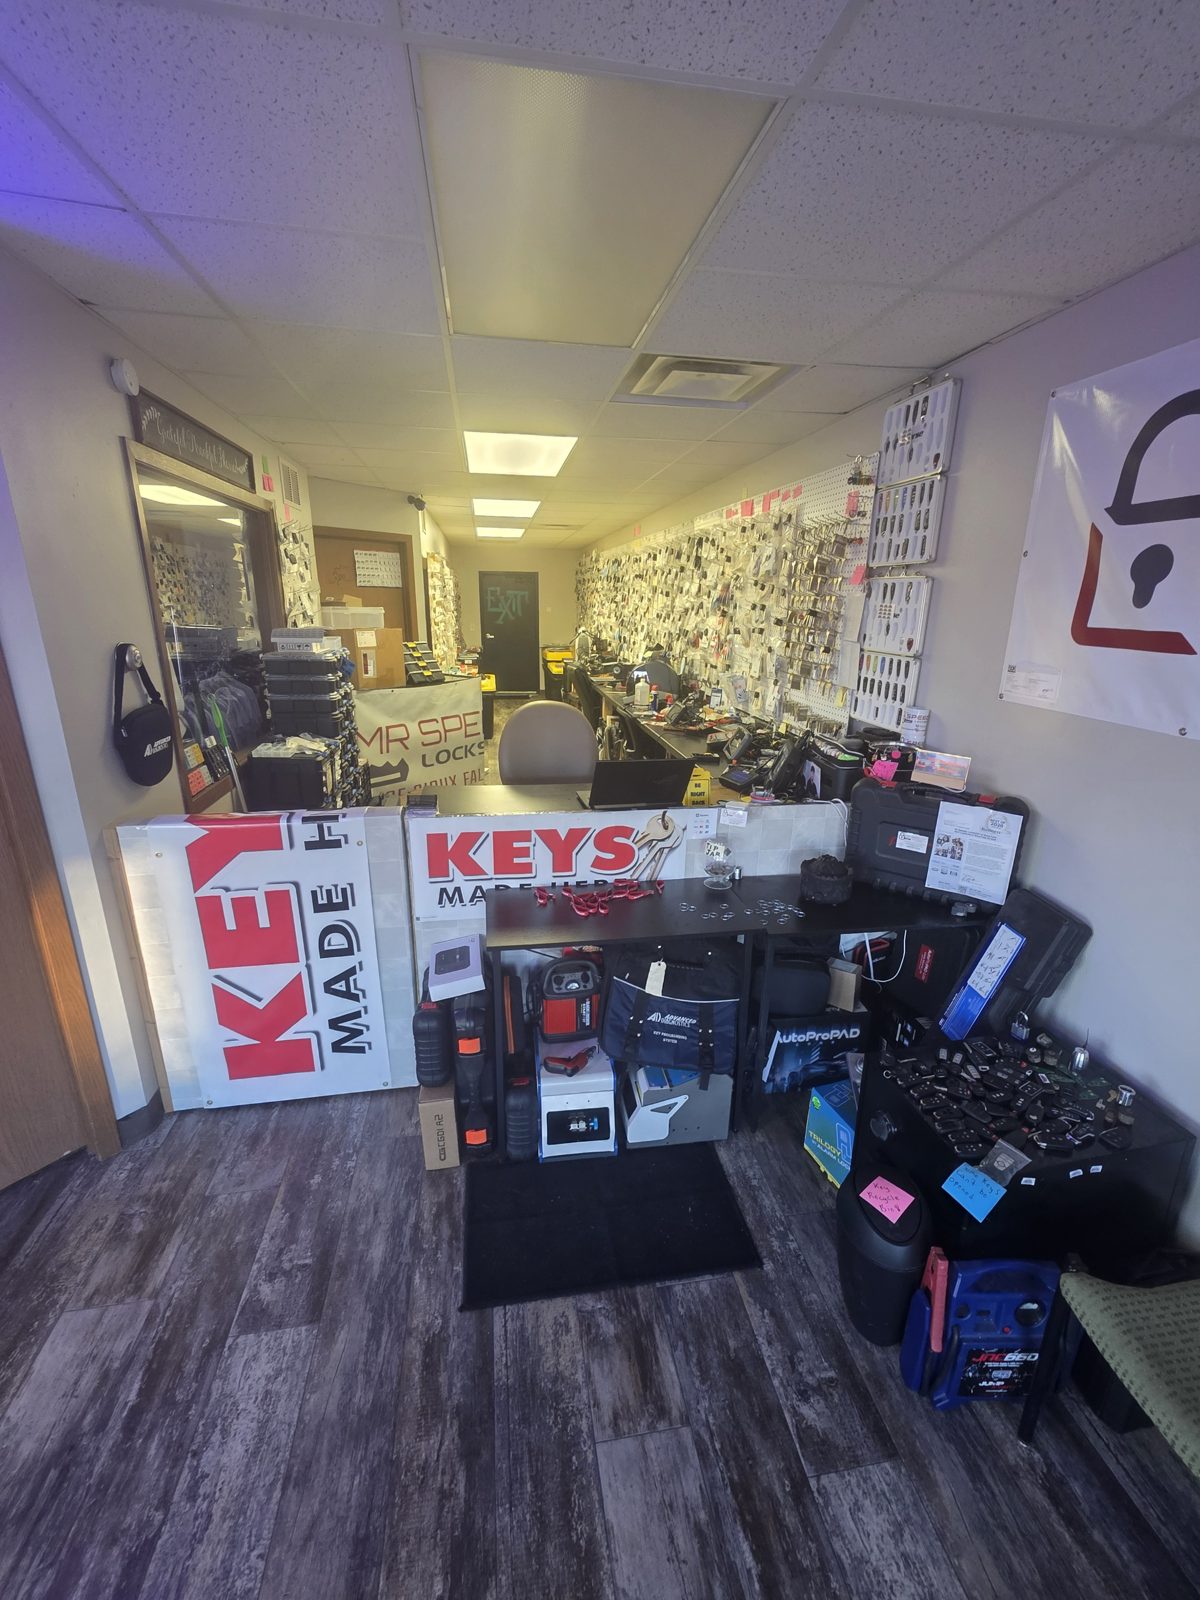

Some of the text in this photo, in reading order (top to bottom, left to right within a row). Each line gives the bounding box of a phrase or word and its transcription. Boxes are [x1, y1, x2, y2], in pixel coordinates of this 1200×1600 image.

[356, 723, 410, 755] MR
[426, 824, 639, 881] KEYS
[311, 883, 372, 1055] MADE
[778, 1028, 861, 1044] AutoProPAD
[808, 1129, 842, 1157] TRILOGY
